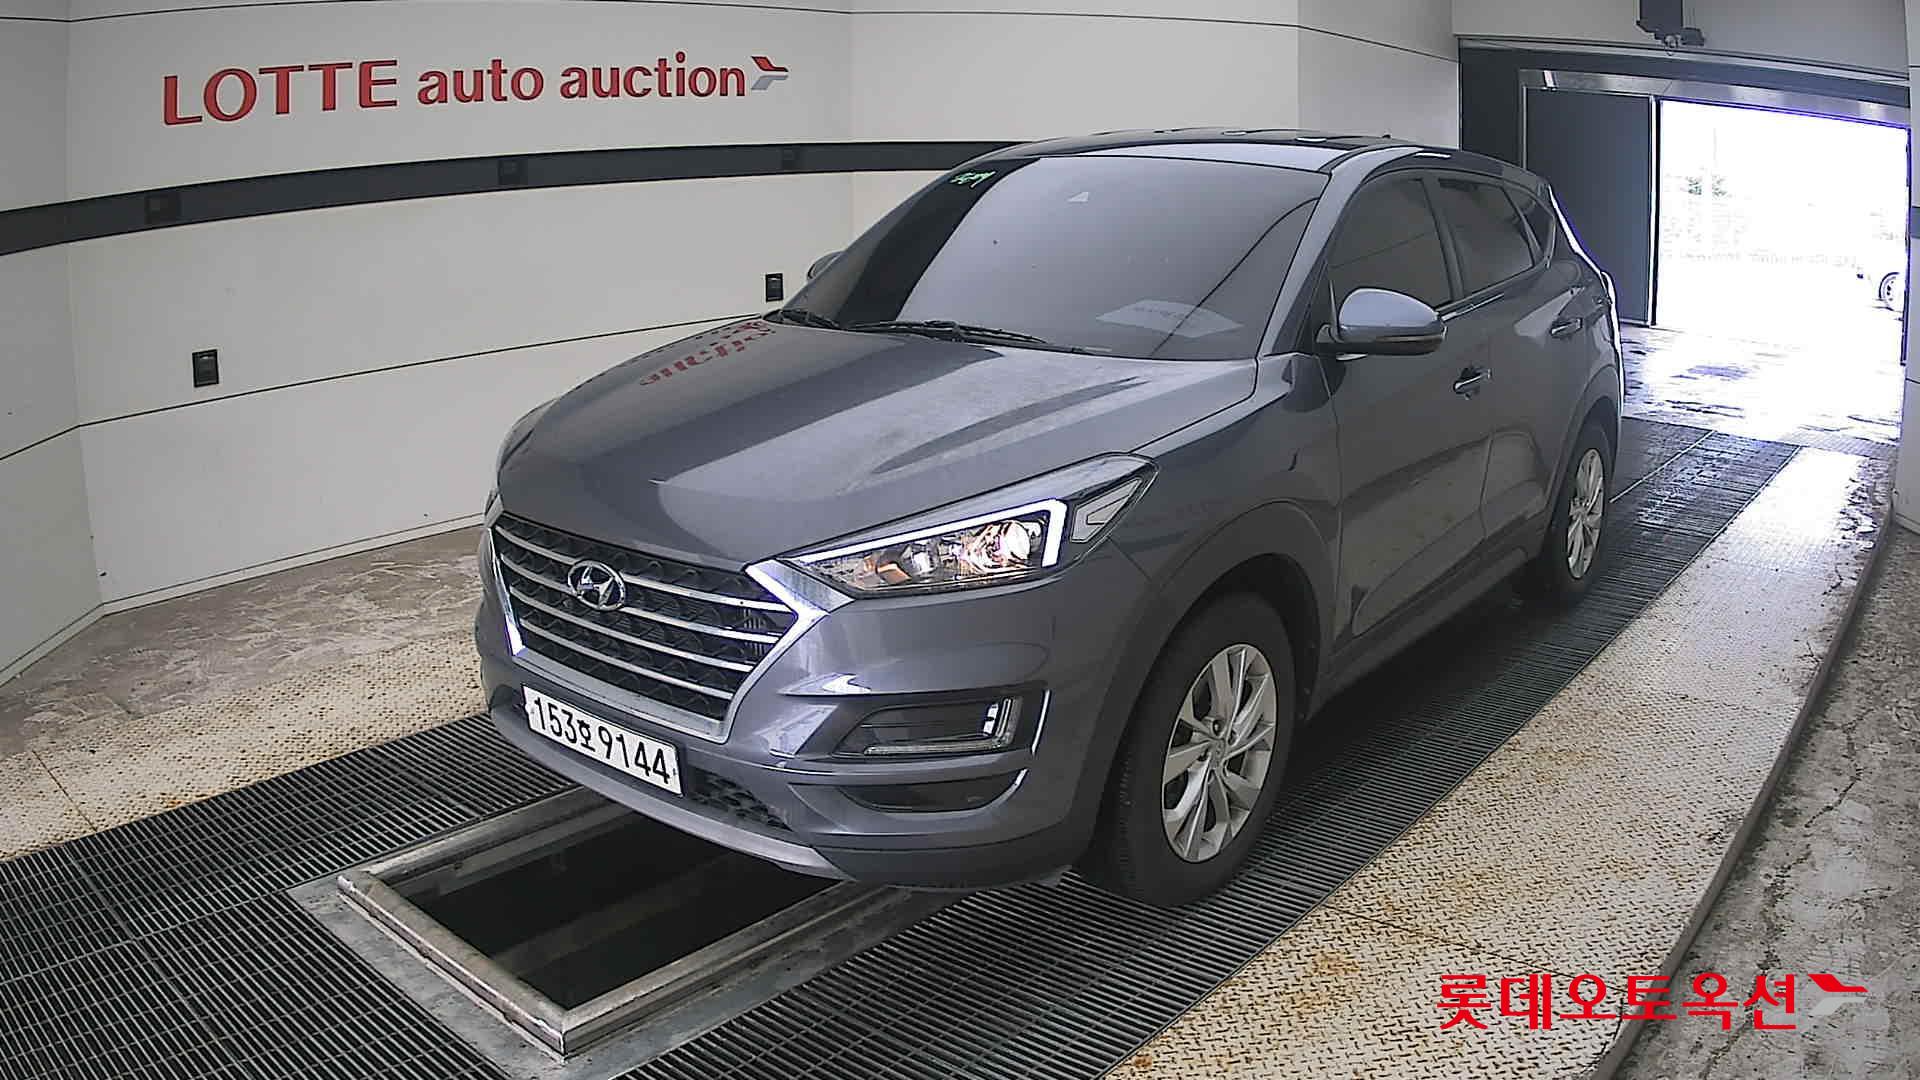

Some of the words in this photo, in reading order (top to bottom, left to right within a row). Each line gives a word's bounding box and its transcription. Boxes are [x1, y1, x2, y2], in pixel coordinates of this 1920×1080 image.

[163, 59, 398, 126] LOTTE
[416, 57, 545, 106] auto
[559, 50, 747, 100] auction
